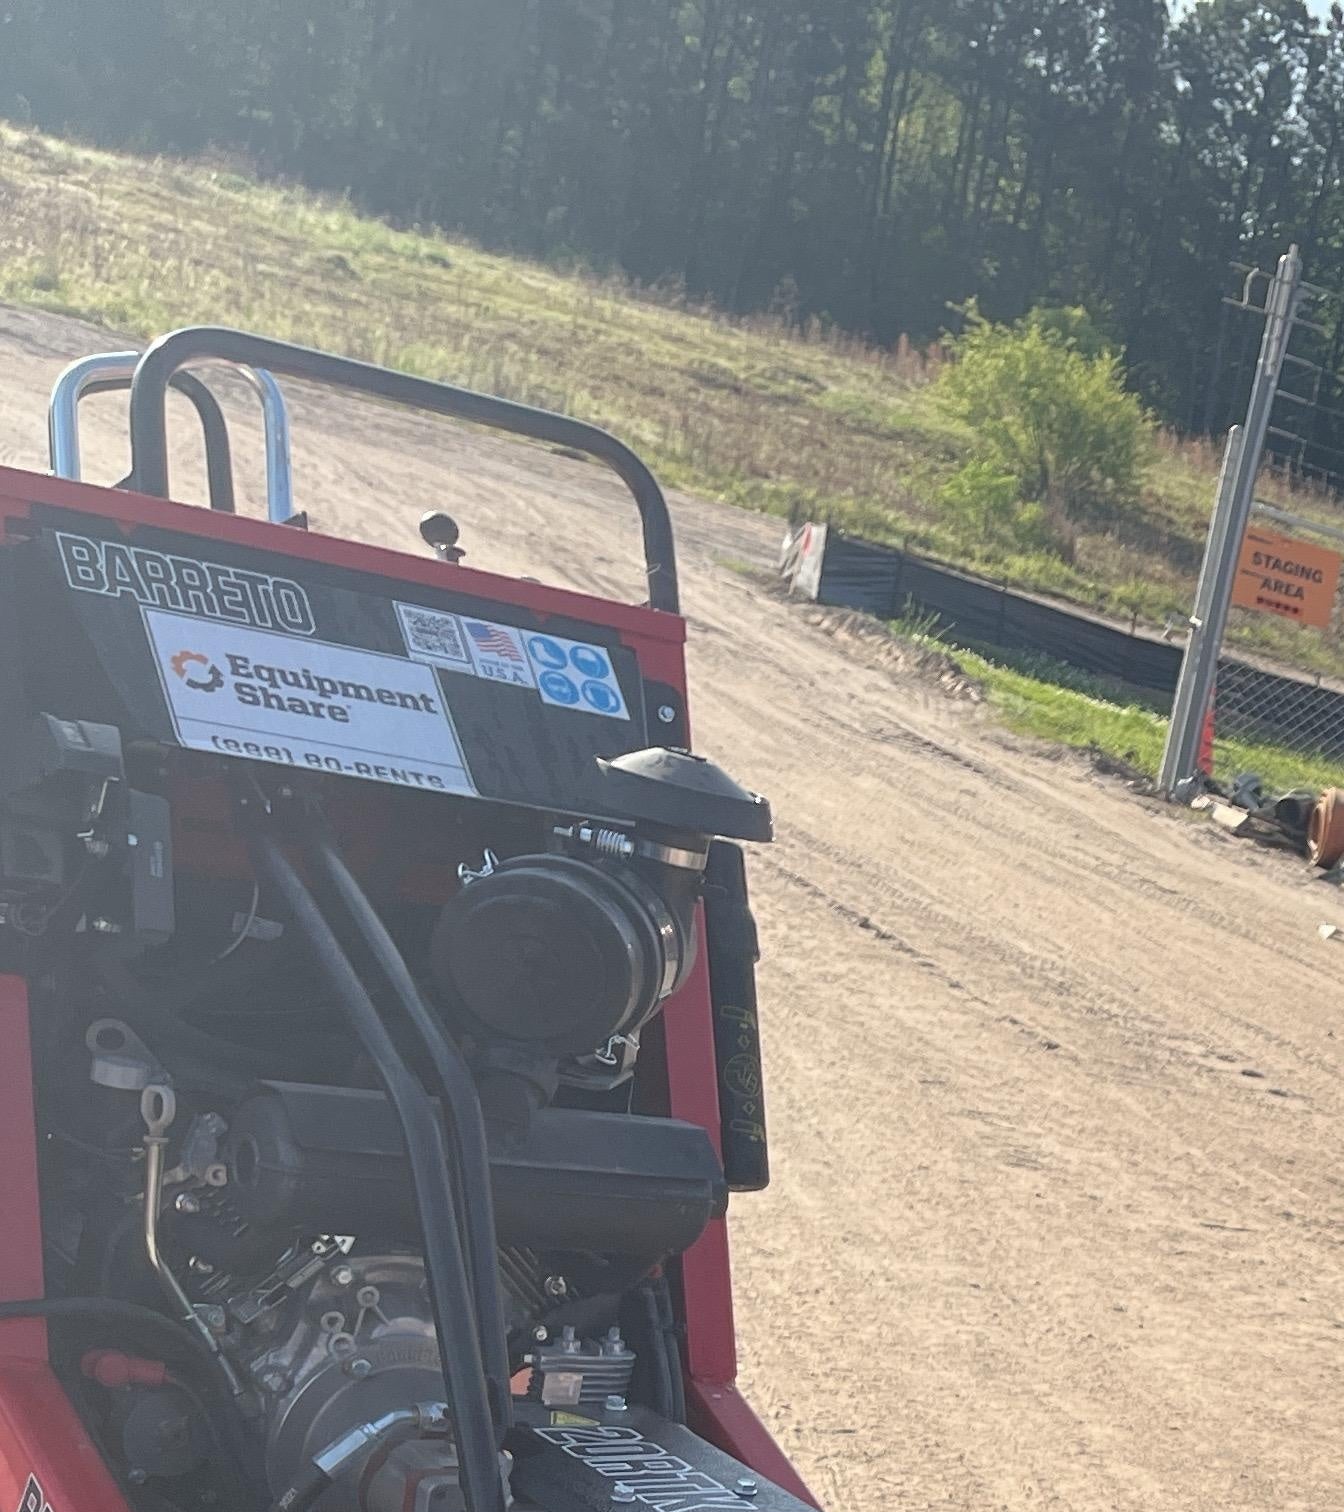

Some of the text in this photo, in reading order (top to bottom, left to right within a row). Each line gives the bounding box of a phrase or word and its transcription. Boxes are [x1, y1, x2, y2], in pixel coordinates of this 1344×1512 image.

[56, 531, 316, 635] BARRETO
[1252, 552, 1323, 583] STAGING
[1260, 578, 1304, 600] AREA
[226, 653, 437, 715] Equipment
[232, 681, 350, 723] Share
